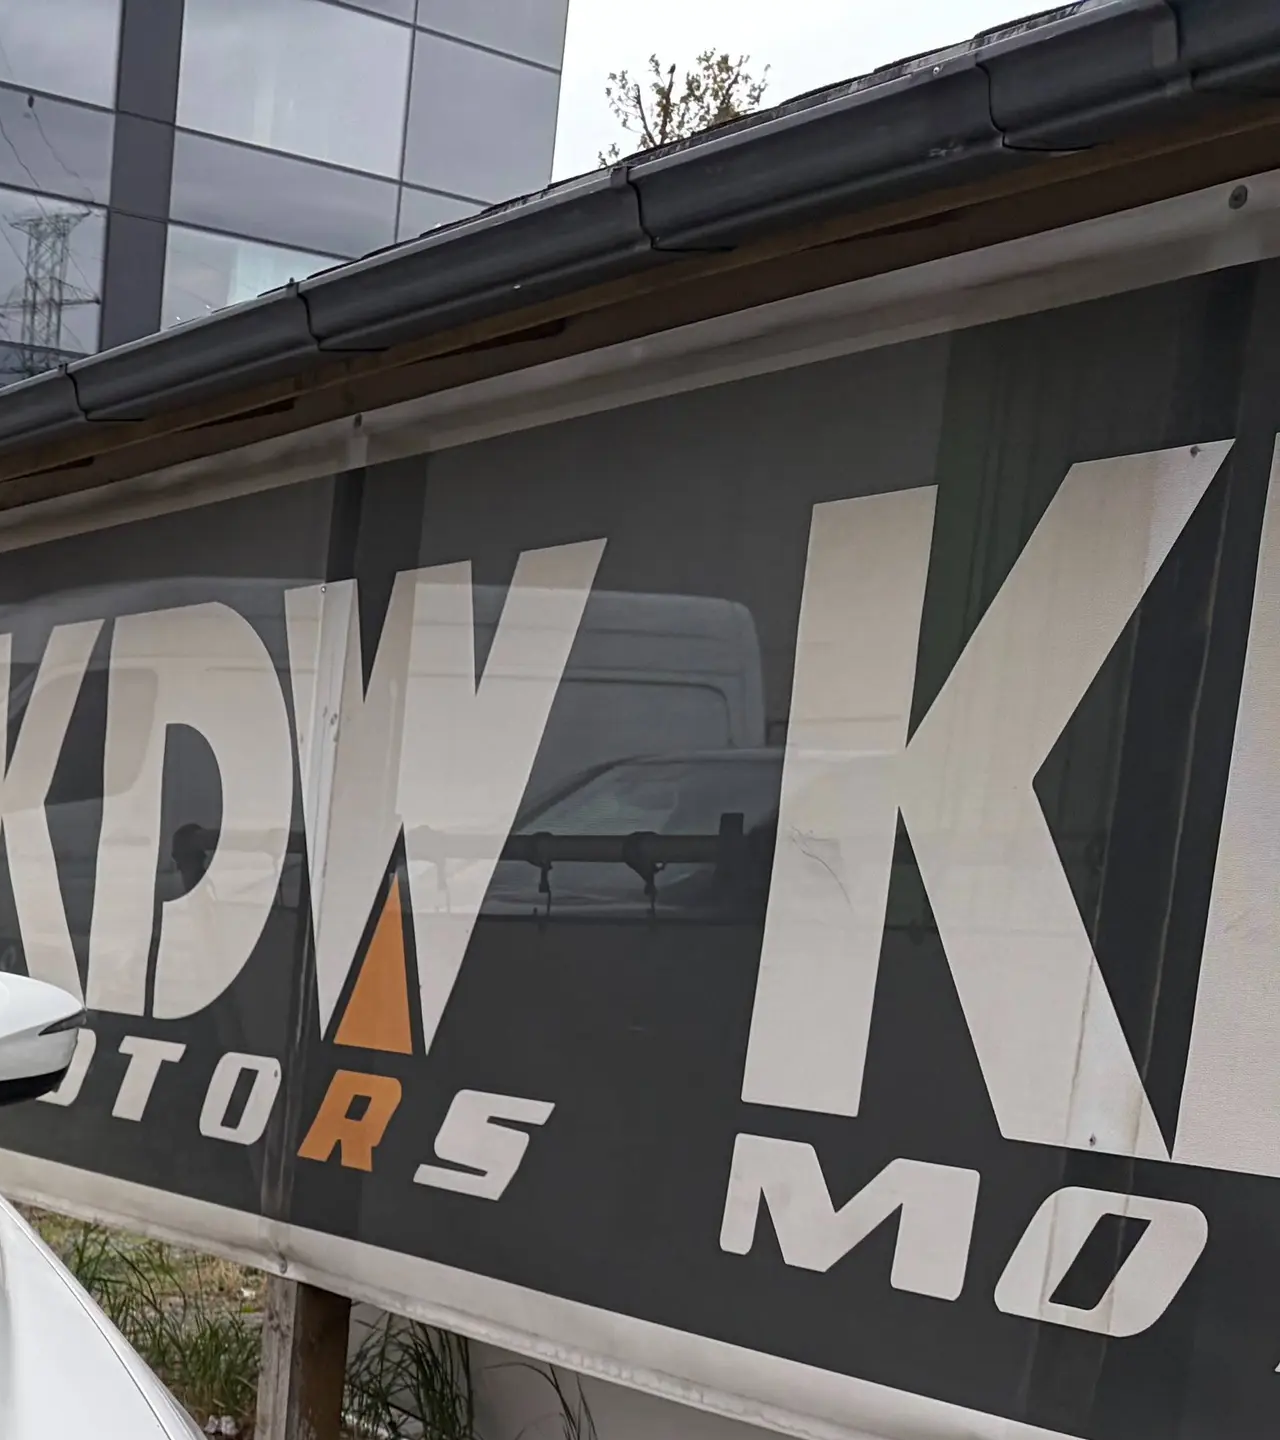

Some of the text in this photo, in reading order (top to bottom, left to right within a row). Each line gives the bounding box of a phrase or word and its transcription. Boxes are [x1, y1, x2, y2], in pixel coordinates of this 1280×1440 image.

[740, 437, 1280, 1175] K
[36, 1028, 556, 1202] TORS
[719, 1133, 1280, 1374] MO
